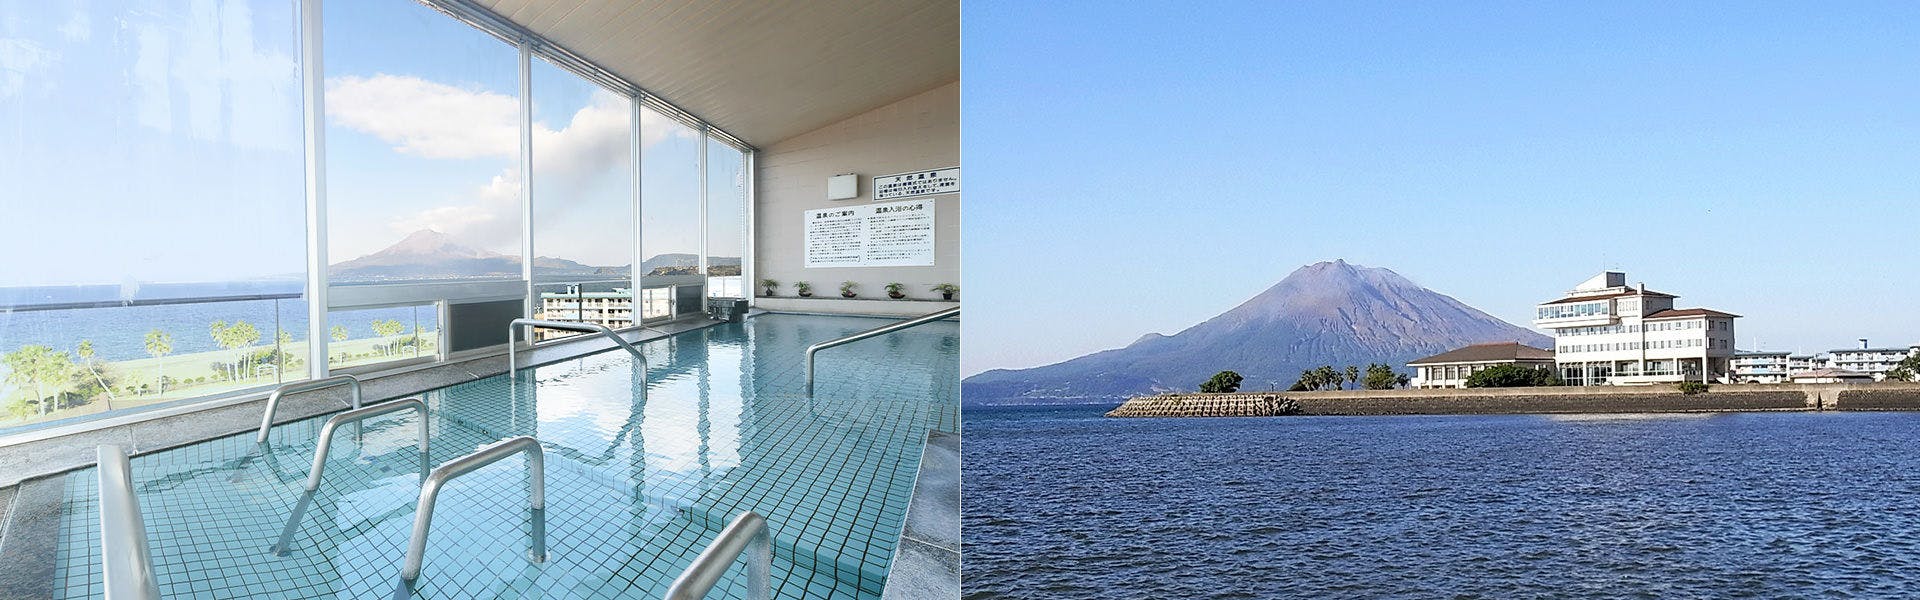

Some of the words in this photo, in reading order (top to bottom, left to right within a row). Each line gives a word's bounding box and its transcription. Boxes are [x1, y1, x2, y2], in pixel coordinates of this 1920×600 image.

[875, 203, 923, 213] 温泉入浴の心得
[816, 210, 855, 219] 温泉のご案内
